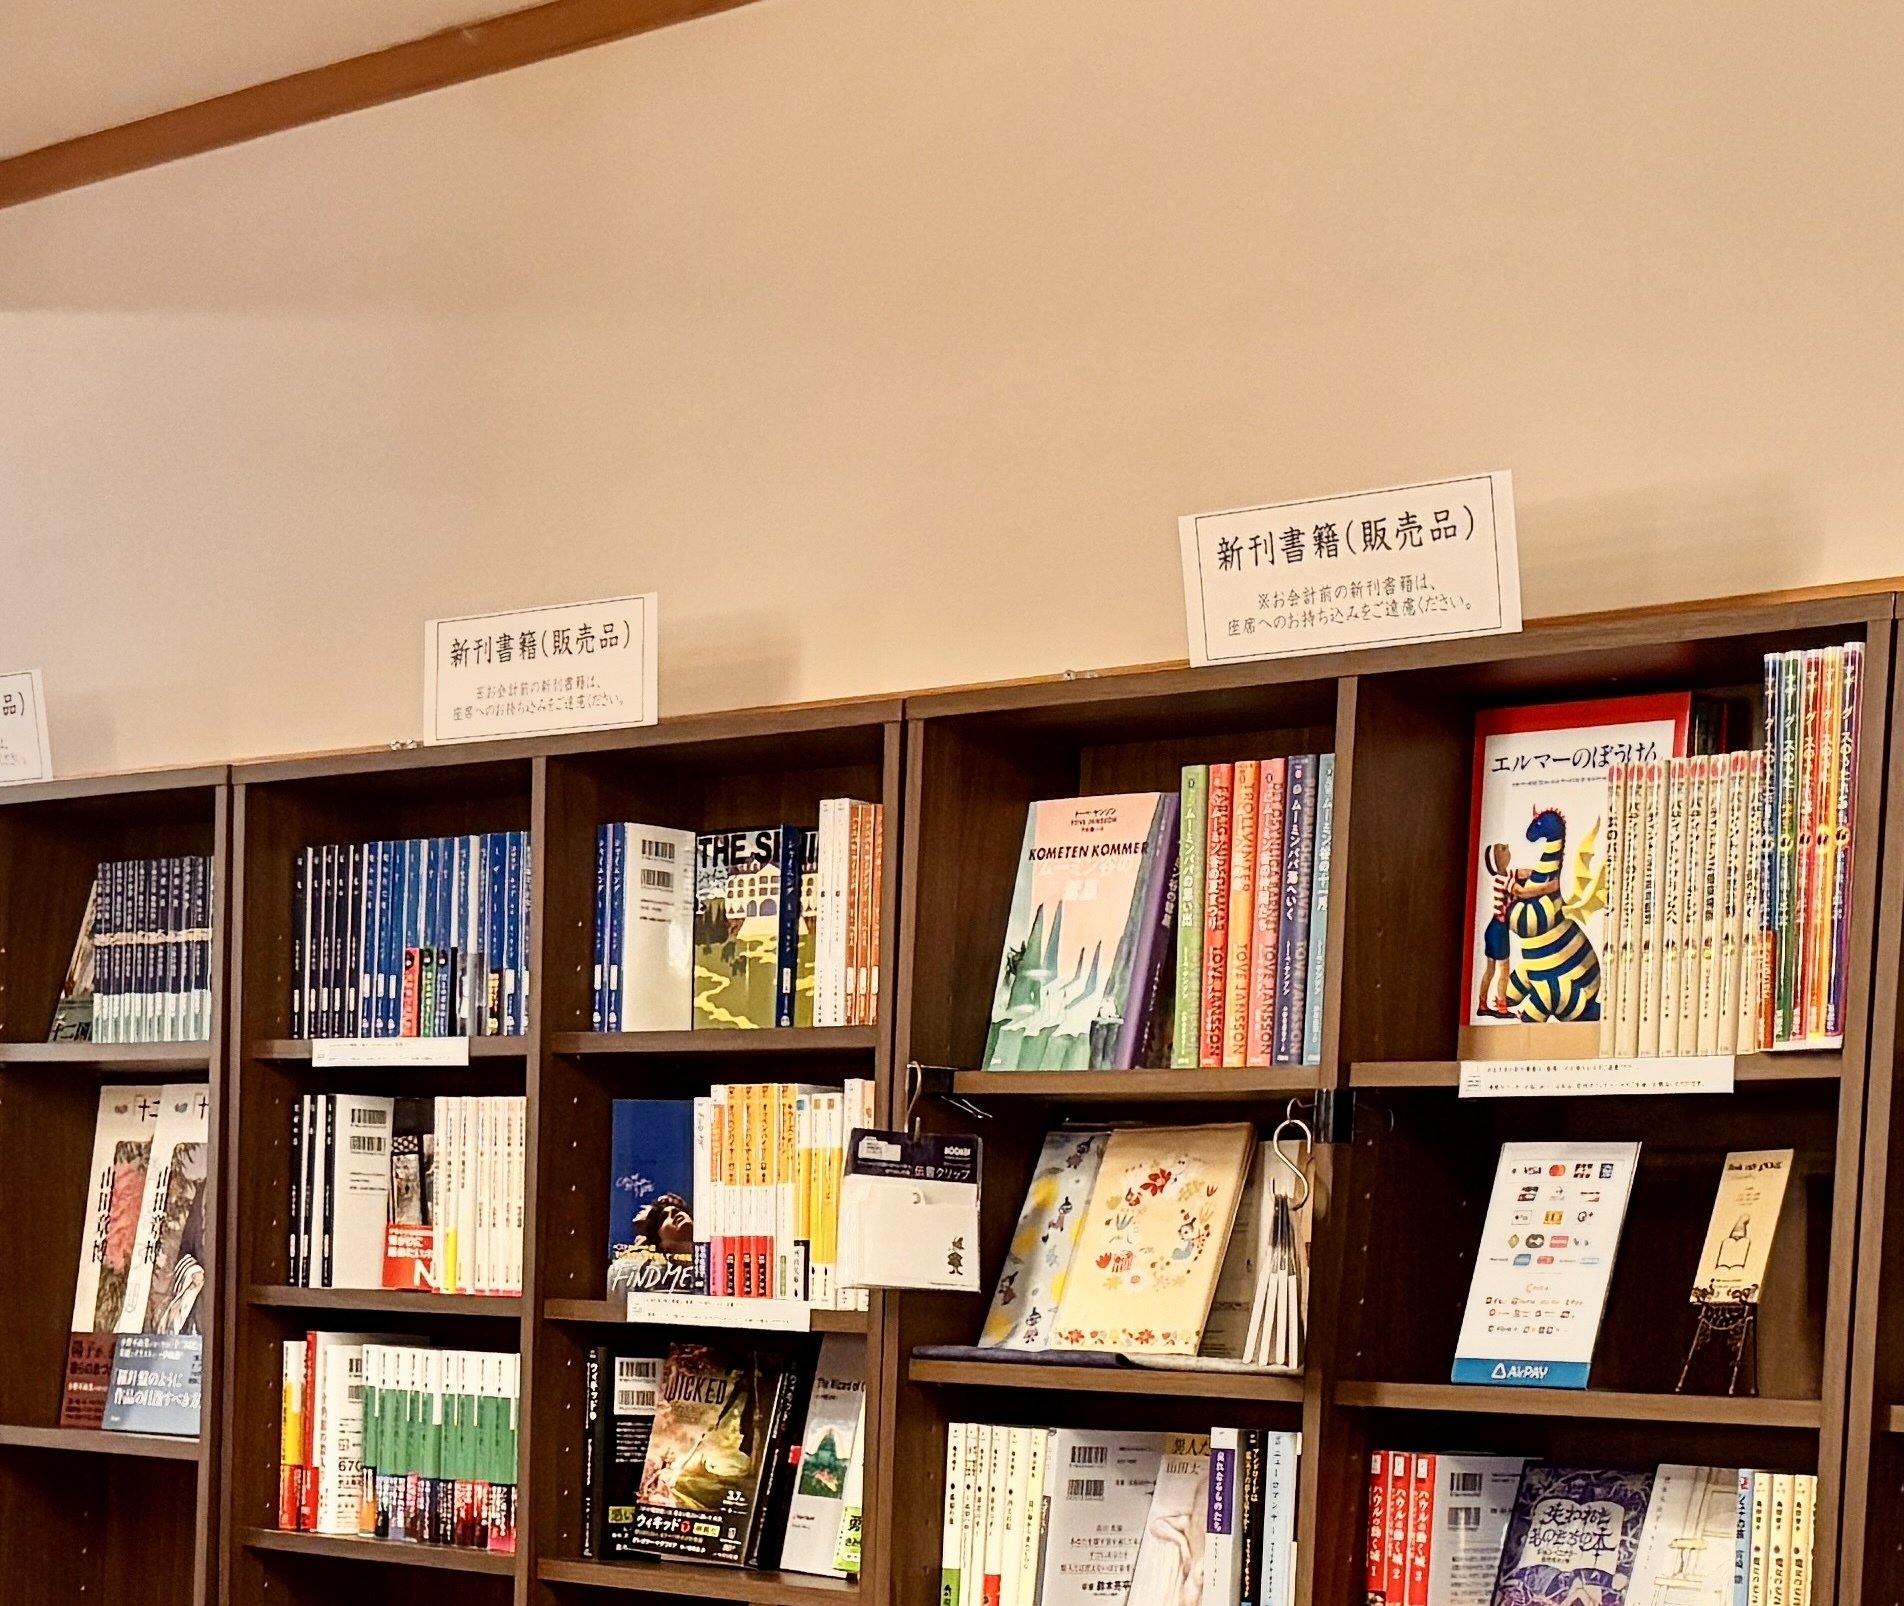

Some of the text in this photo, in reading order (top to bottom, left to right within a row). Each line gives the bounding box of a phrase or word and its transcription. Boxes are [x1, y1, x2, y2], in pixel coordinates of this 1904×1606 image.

[1217, 504, 1475, 572] 新刊書籍(販売品)
[450, 620, 631, 668] 新刊書籍(販売品)
[1492, 741, 1660, 773] エルマーのぼうけん
[698, 832, 747, 868] THE
[1028, 841, 1149, 861] KOMETEN KOMMER
[663, 1374, 728, 1404] WICKED
[635, 1515, 680, 1532] ウィキッド
[1367, 1483, 1383, 1564] ハウルの動く城
[1392, 1486, 1408, 1566] ハウルの動く城
[1413, 1486, 1430, 1568] ハウルの動く城
[1539, 1503, 1613, 1527] 失われた
[1528, 1526, 1616, 1553] ものたちの本
